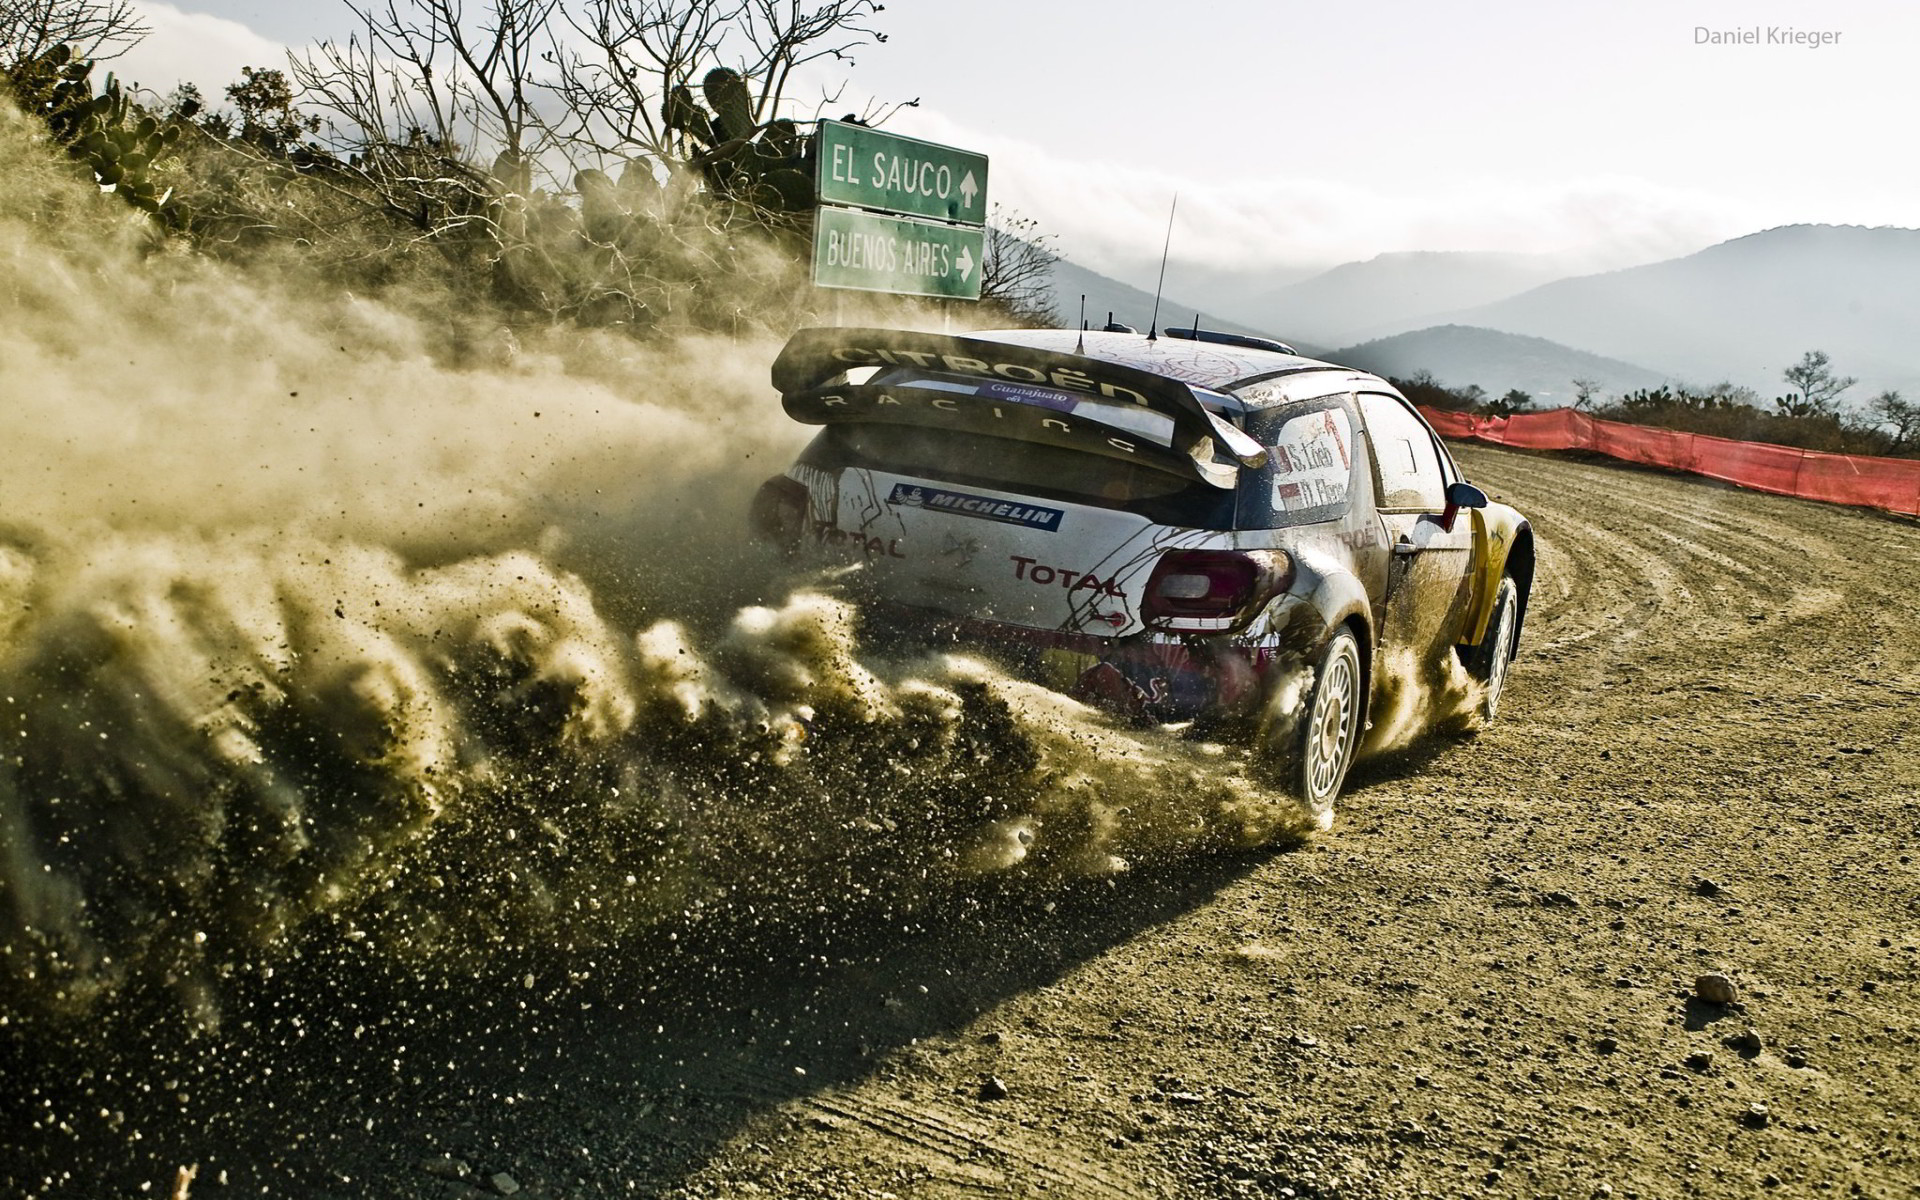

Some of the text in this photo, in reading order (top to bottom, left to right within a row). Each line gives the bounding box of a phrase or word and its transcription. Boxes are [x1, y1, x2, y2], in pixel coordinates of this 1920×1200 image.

[832, 143, 951, 199] EL SAUCO
[827, 229, 950, 278] BUENOS AIRES
[991, 383, 1068, 402] Guanajuato
[930, 493, 1055, 525] MICHELIN
[1010, 555, 1127, 598] TOTAL
